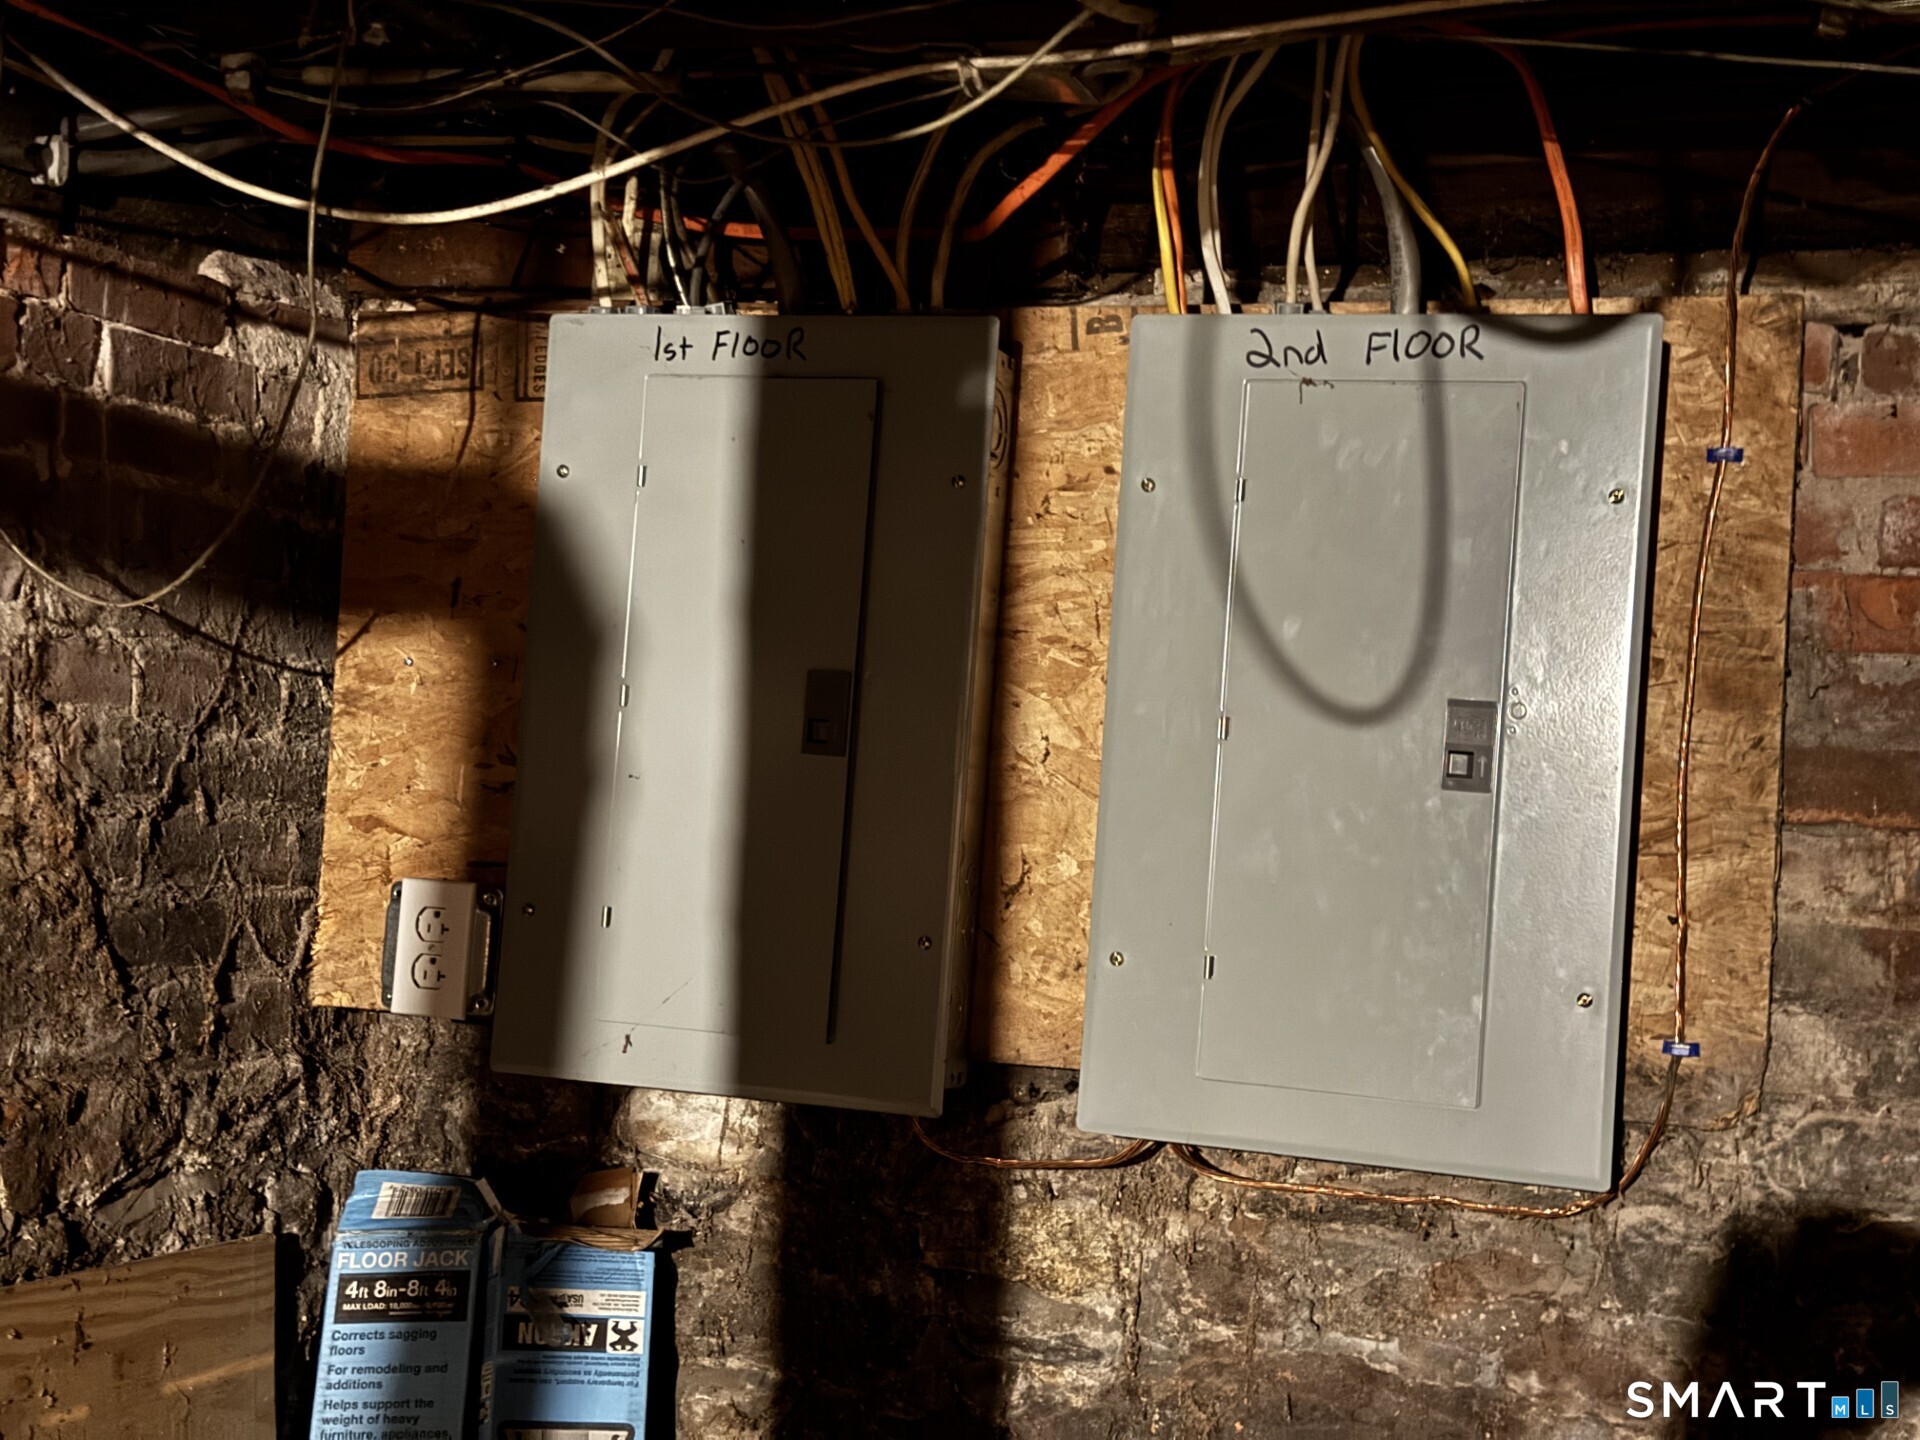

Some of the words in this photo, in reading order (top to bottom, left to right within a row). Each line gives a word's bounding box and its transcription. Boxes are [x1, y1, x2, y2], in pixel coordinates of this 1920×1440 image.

[655, 325, 694, 361] 1st
[1246, 327, 1327, 368] 2nd
[337, 1251, 408, 1269] FLOOR
[413, 1250, 469, 1268] JACK
[345, 1281, 369, 1298] 4ft
[567, 1294, 584, 1304] USA
[342, 1303, 361, 1311] MAX
[362, 1302, 387, 1310] LOAD:
[331, 1330, 385, 1341] Corrects
[388, 1328, 438, 1342] sagging
[329, 1345, 365, 1356] floors
[327, 1364, 348, 1375] For
[351, 1363, 421, 1376] remodeling
[424, 1363, 449, 1373] and
[325, 1380, 383, 1390] additions
[323, 1399, 359, 1411] Helps
[362, 1400, 411, 1411] support
[414, 1398, 434, 1409] the
[321, 1414, 363, 1427] weight
[366, 1413, 380, 1425] of
[383, 1413, 420, 1426] heavy
